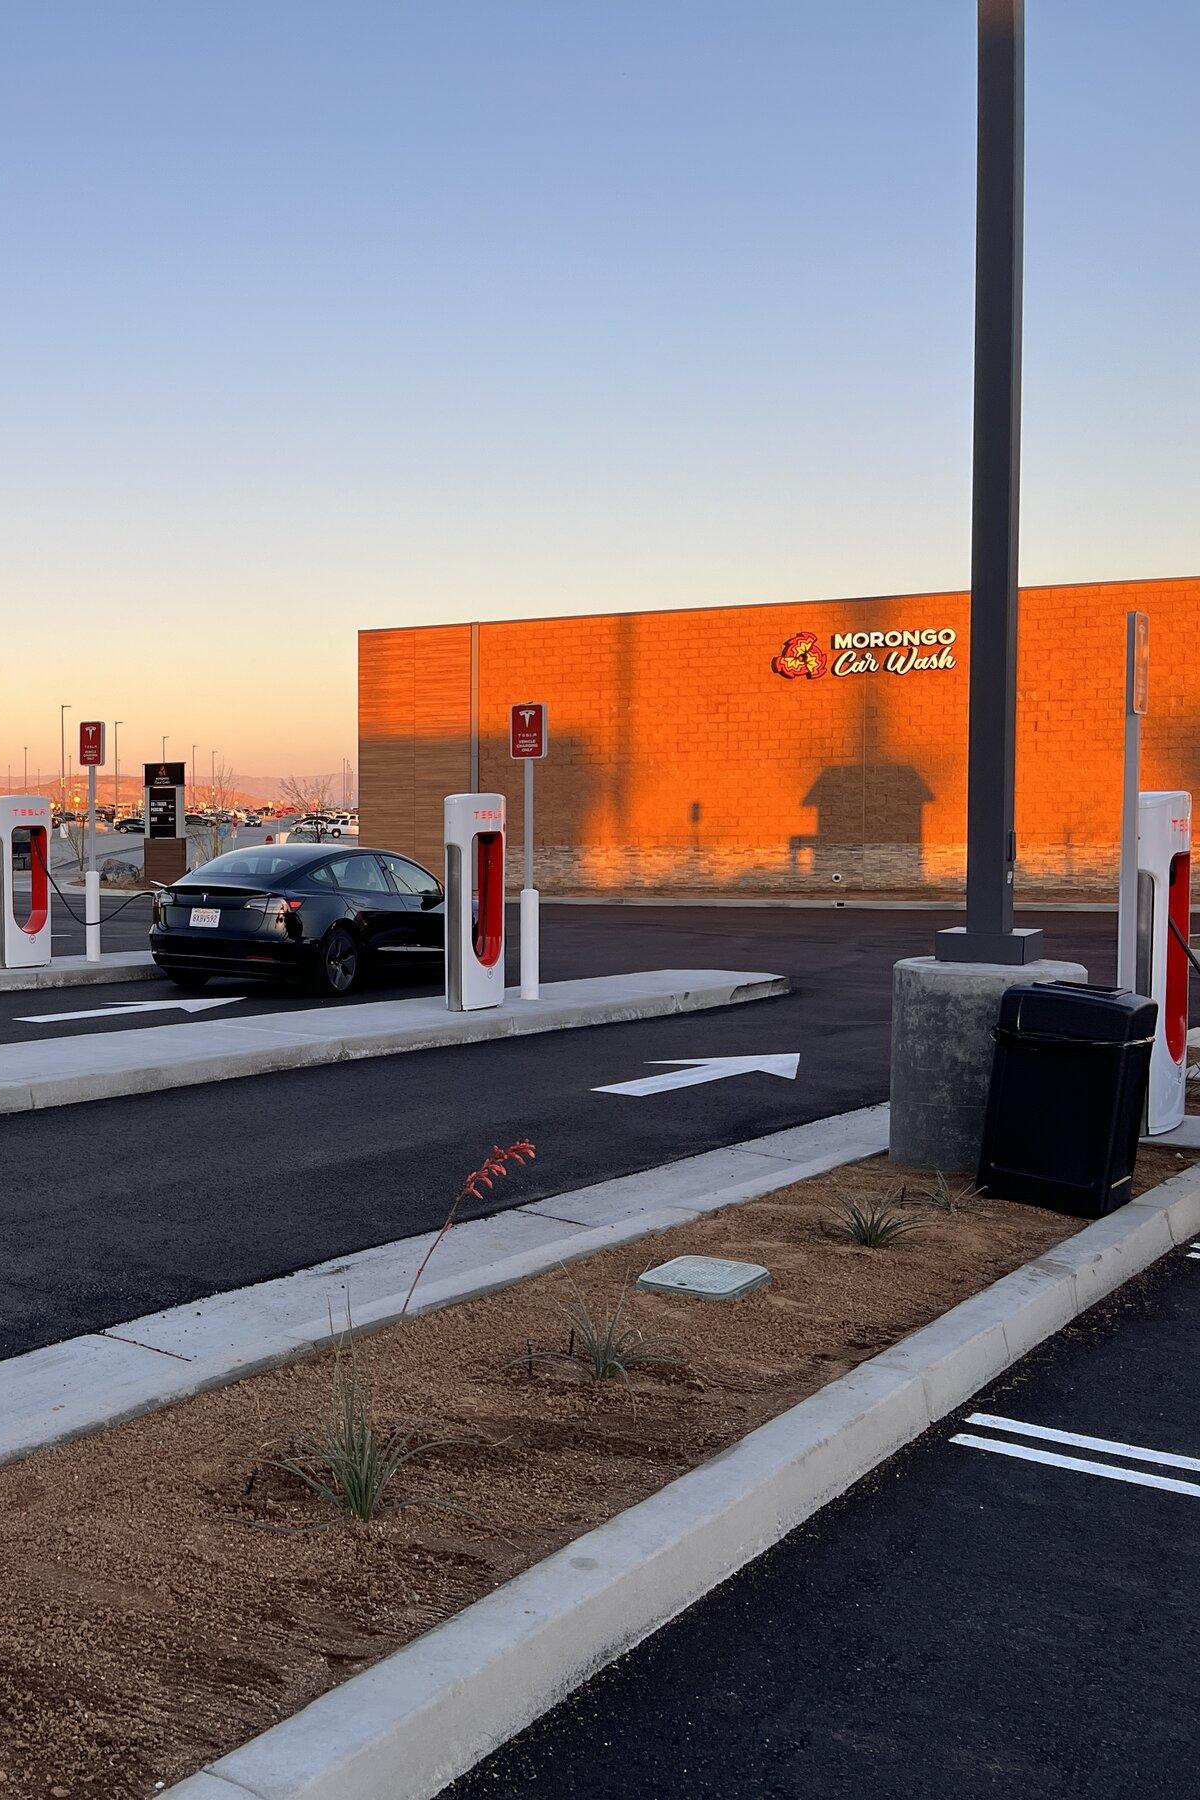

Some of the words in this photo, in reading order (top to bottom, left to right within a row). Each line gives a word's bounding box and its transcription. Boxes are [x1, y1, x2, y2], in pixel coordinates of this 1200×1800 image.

[833, 628, 956, 649] MORONGO
[833, 650, 879, 677] Car
[886, 646, 956, 675] Wash
[11, 808, 46, 816] TESLA
